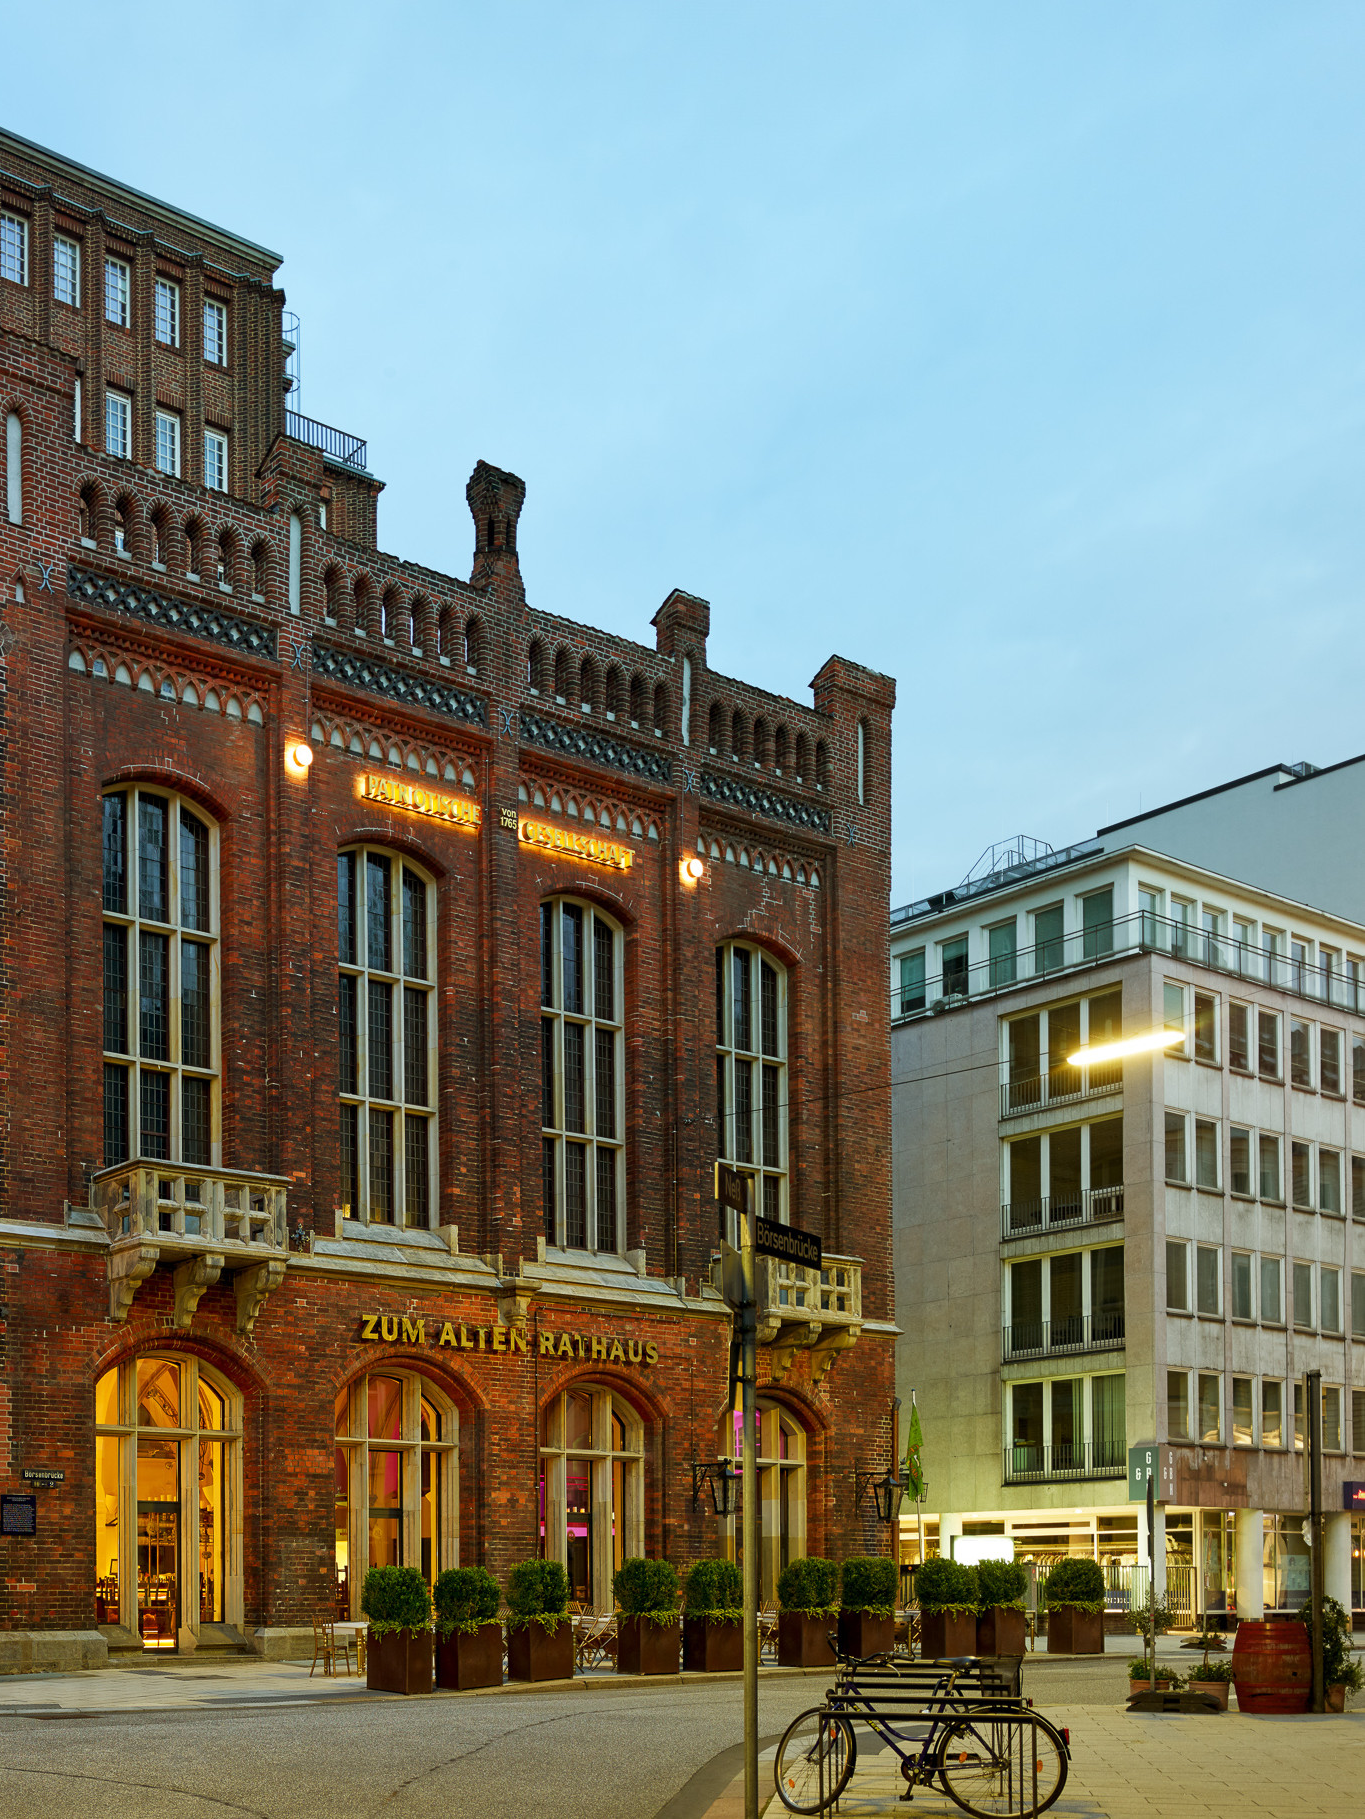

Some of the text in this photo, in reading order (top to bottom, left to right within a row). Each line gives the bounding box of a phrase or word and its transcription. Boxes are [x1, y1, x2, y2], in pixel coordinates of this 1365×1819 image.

[365, 774, 482, 826] PATRIOTISCHE
[501, 807, 517, 818] von
[500, 816, 518, 830] 1765
[522, 820, 636, 869] GESELLSCHAFT
[725, 1173, 741, 1201] Neß
[757, 1222, 818, 1262] Börsenbrücke
[361, 1314, 660, 1365] ZUM ALTEN RATHAUS
